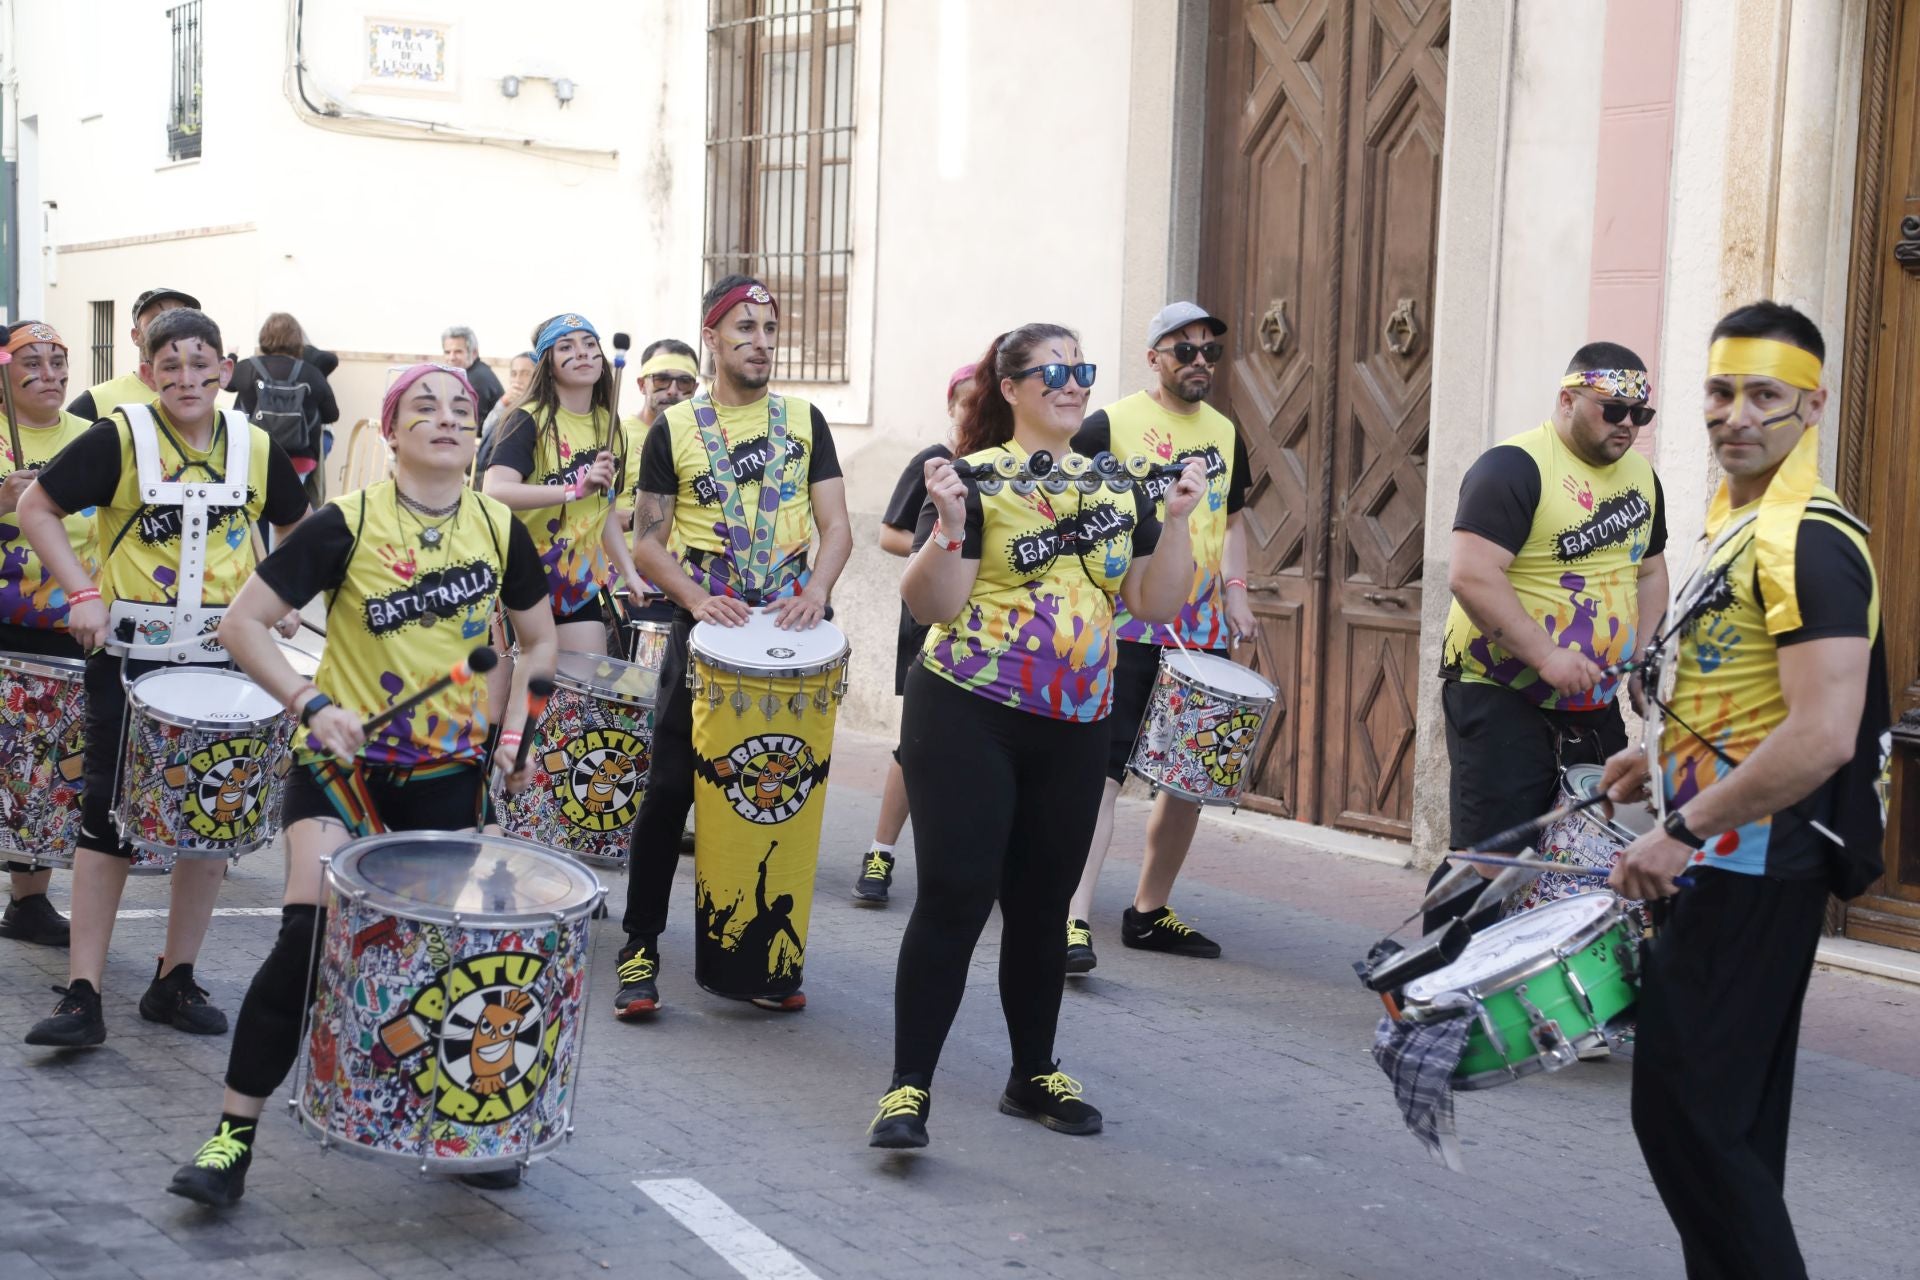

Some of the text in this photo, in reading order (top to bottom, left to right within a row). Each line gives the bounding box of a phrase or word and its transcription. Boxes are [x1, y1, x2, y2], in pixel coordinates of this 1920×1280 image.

[1563, 496, 1649, 555] BATUTRALLA
[368, 568, 494, 626] BATUTRALLA
[190, 738, 268, 773] BATU
[566, 730, 645, 759] BATU
[731, 736, 803, 765] BATU
[413, 955, 542, 1021] BATU
